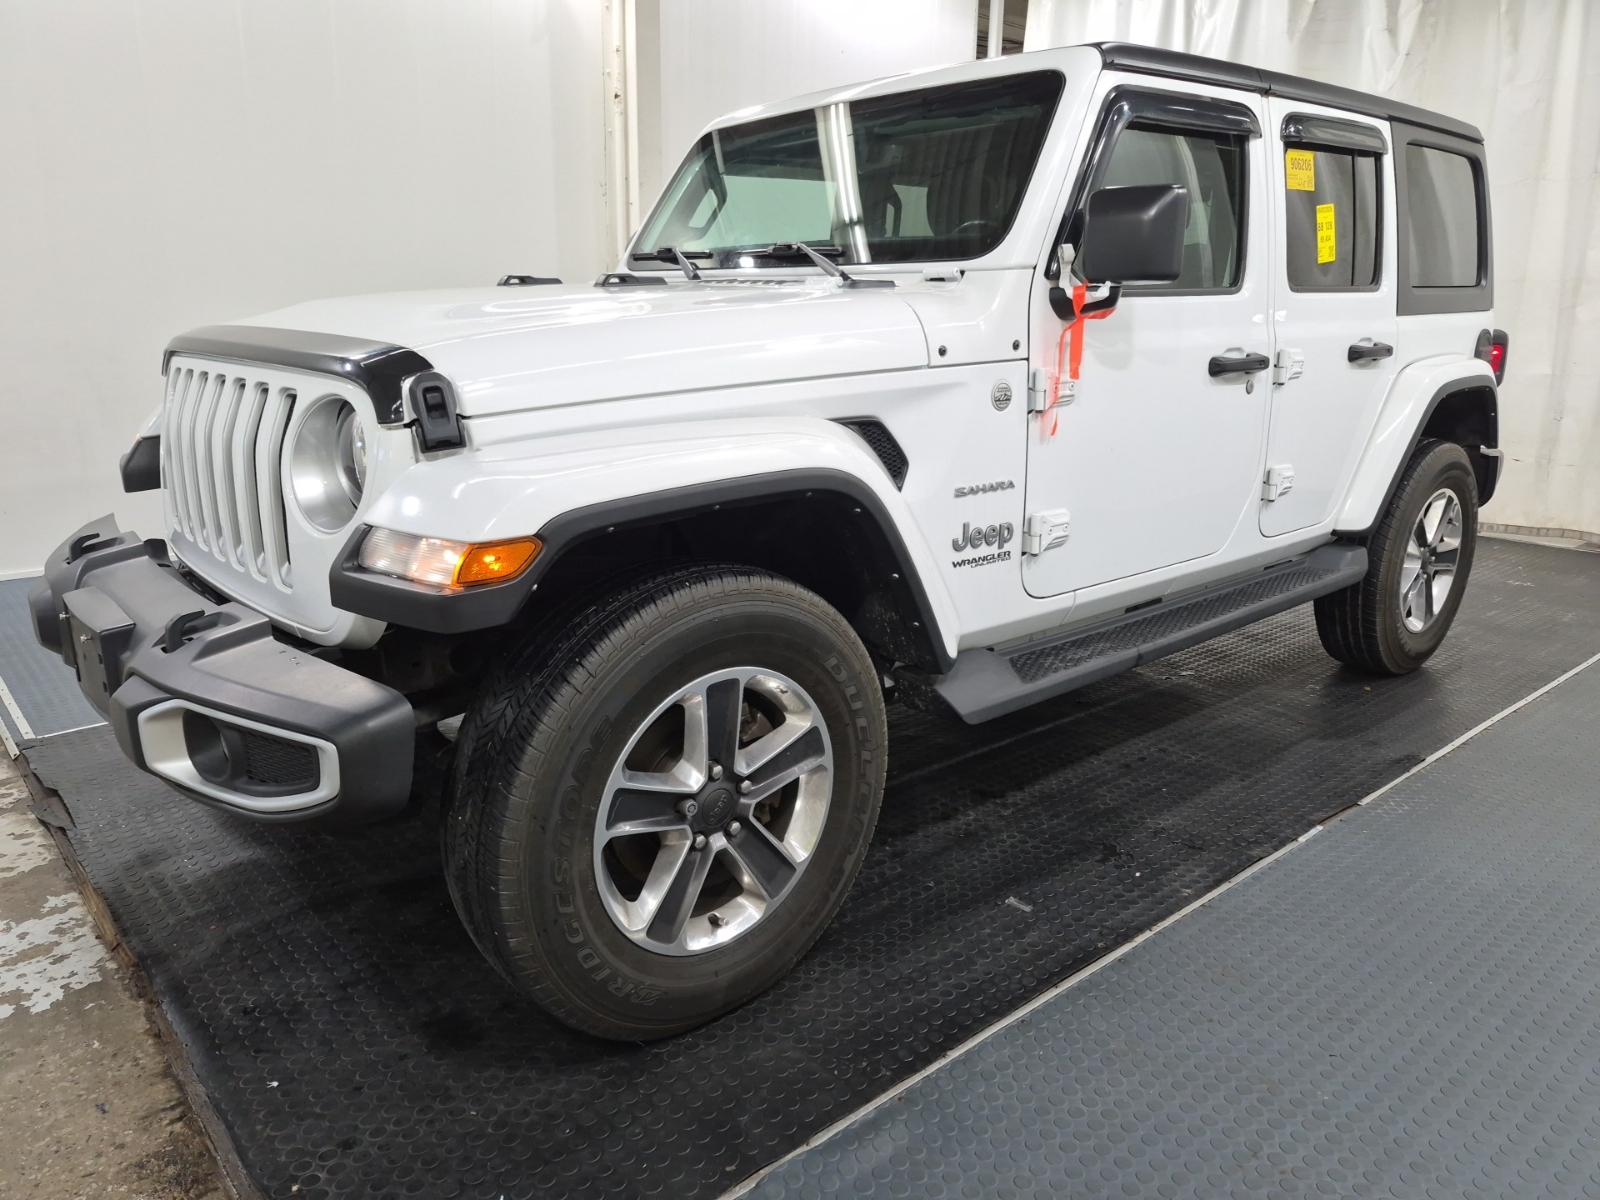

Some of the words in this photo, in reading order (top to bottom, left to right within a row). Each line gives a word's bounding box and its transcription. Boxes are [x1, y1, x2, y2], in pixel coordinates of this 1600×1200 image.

[1290, 157, 1312, 171] 906206
[954, 480, 1015, 498] SAHARA
[952, 521, 1014, 552] Jeep
[952, 550, 1011, 568] WRANGLER
[970, 556, 1011, 568] UNLIMITED
[554, 715, 667, 1007] BRIDGESTONE
